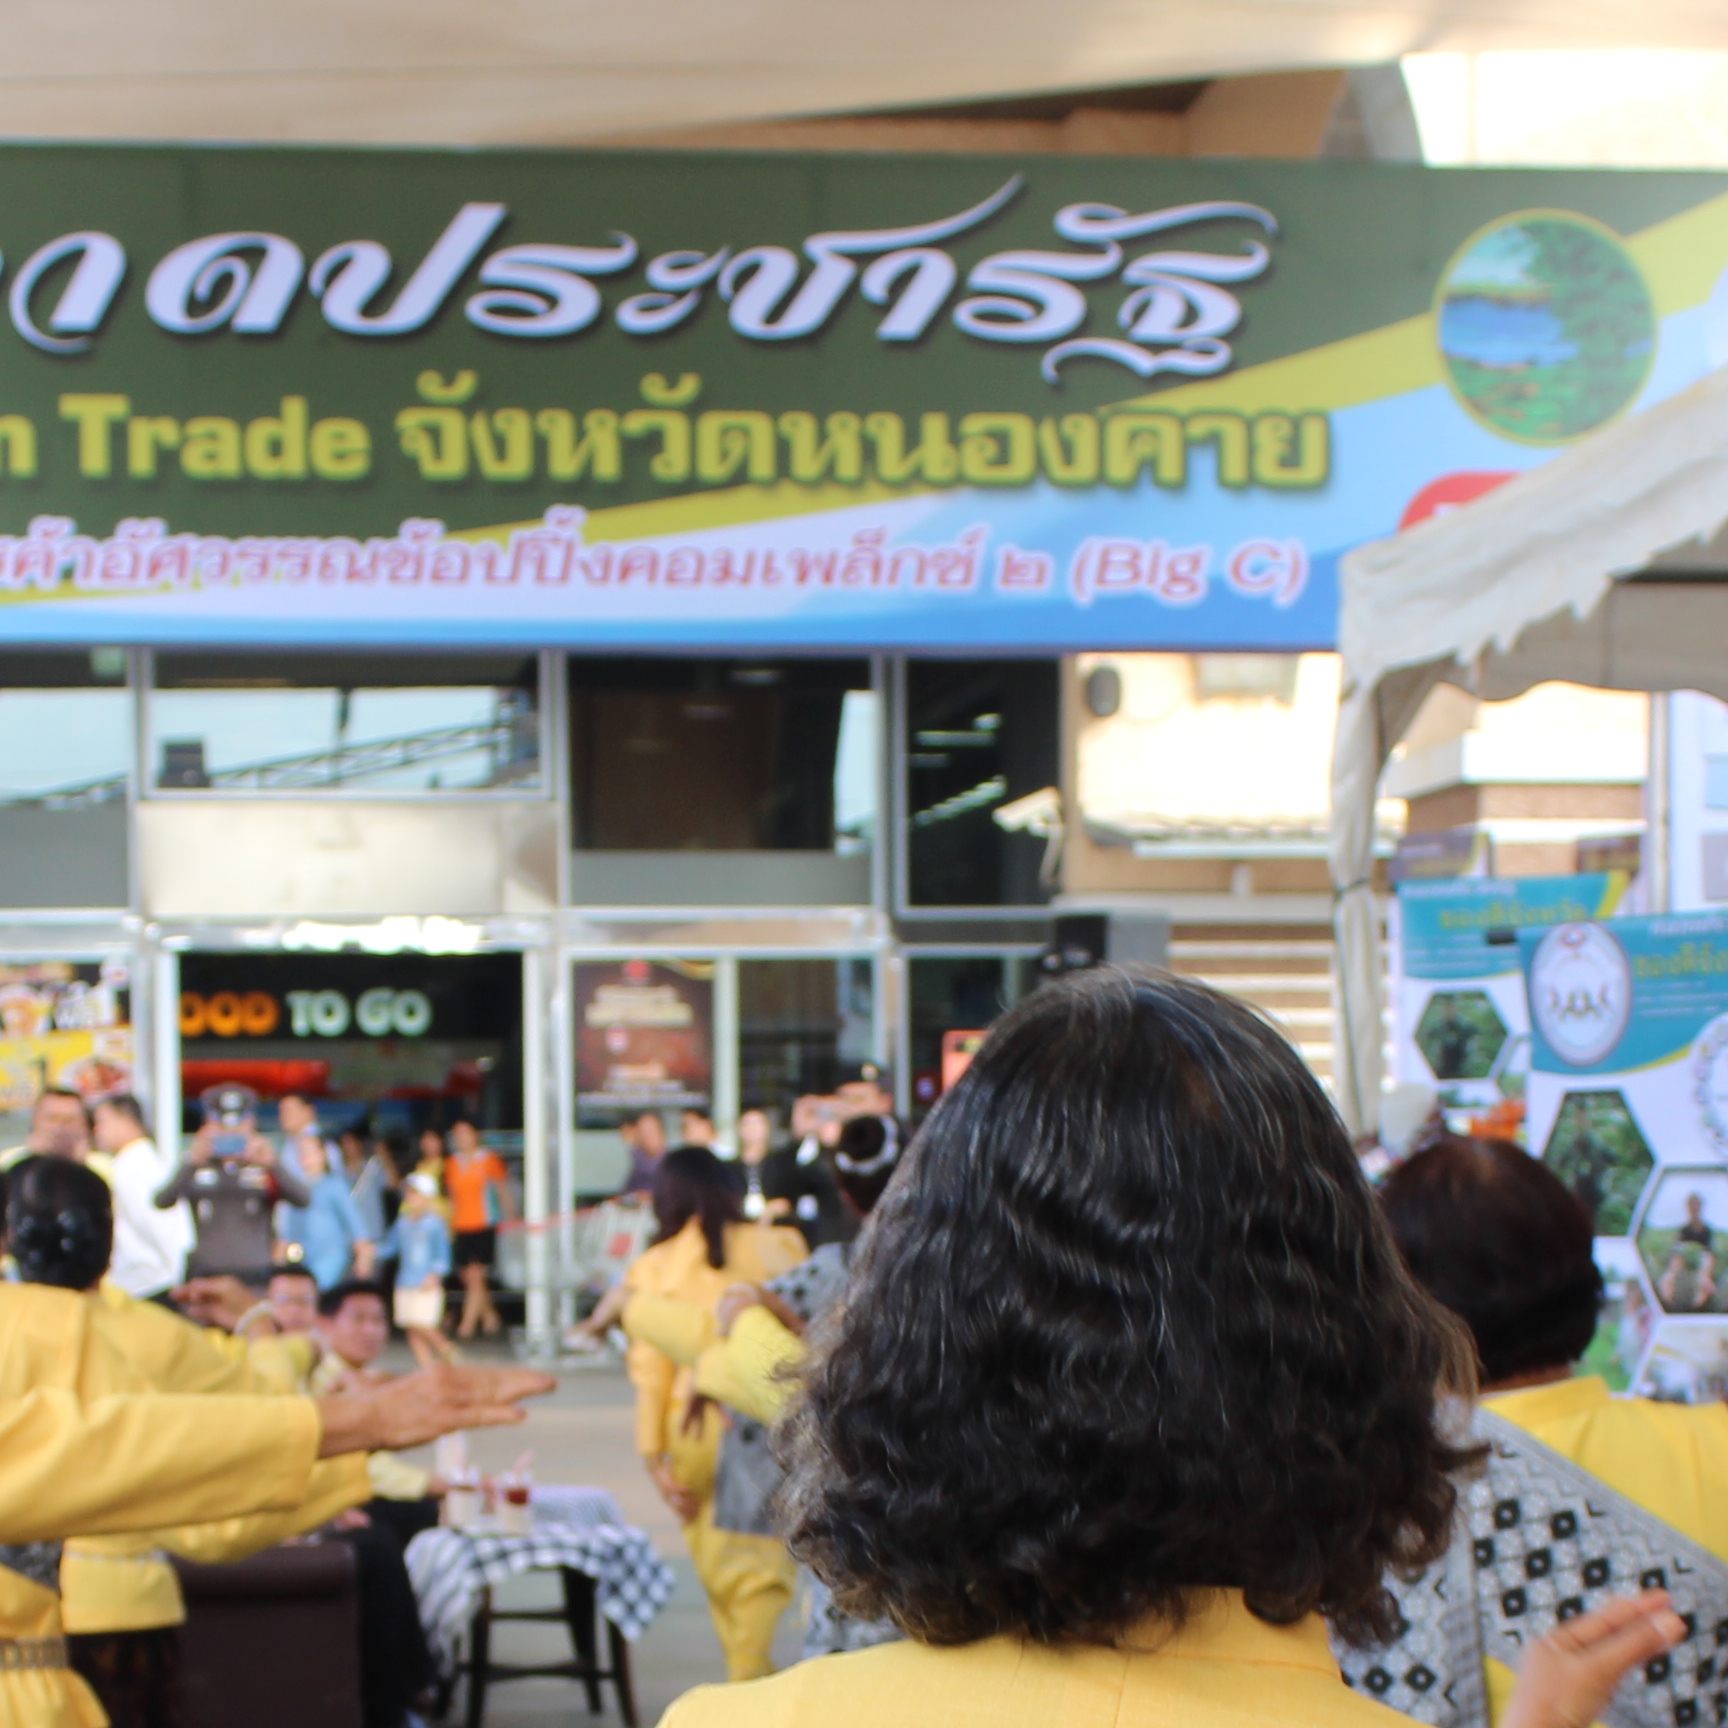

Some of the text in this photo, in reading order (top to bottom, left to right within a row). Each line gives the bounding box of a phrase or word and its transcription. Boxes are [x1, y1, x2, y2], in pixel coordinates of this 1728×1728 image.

[59, 392, 372, 479] Trade
[394, 370, 1332, 488] จังหวัดหนองคาย
[1224, 536, 1310, 608] C)
[285, 988, 350, 1038] TO
[355, 986, 433, 1038] GO
